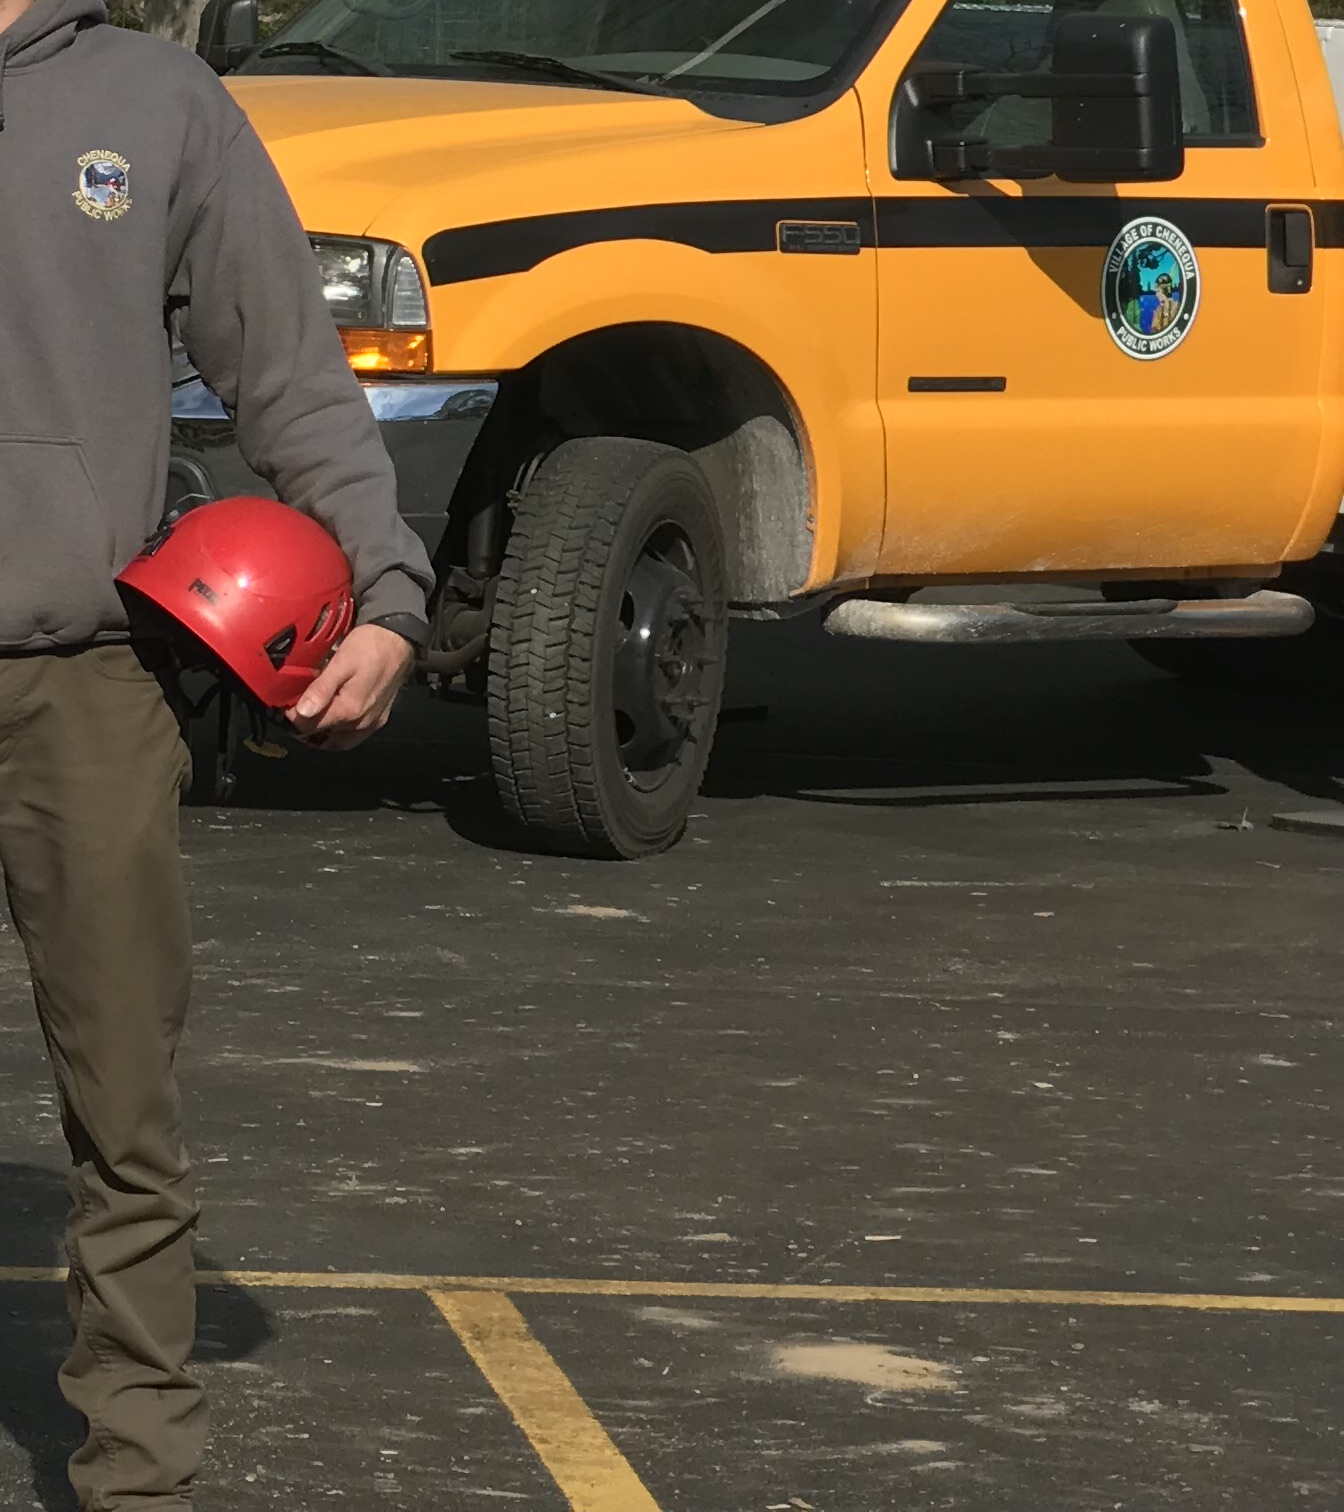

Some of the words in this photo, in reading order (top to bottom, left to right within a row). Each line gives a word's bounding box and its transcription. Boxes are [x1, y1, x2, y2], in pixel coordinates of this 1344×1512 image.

[76, 149, 131, 172] CHENEQUA
[71, 190, 103, 220] PUBLIC
[103, 198, 133, 221] WORKS
[1109, 228, 1140, 274] VILLAGE
[1140, 224, 1154, 238] OF
[1155, 225, 1196, 281] CHENEQUA
[1116, 326, 1148, 353] PUBLIC
[1148, 326, 1182, 353] WORKS
